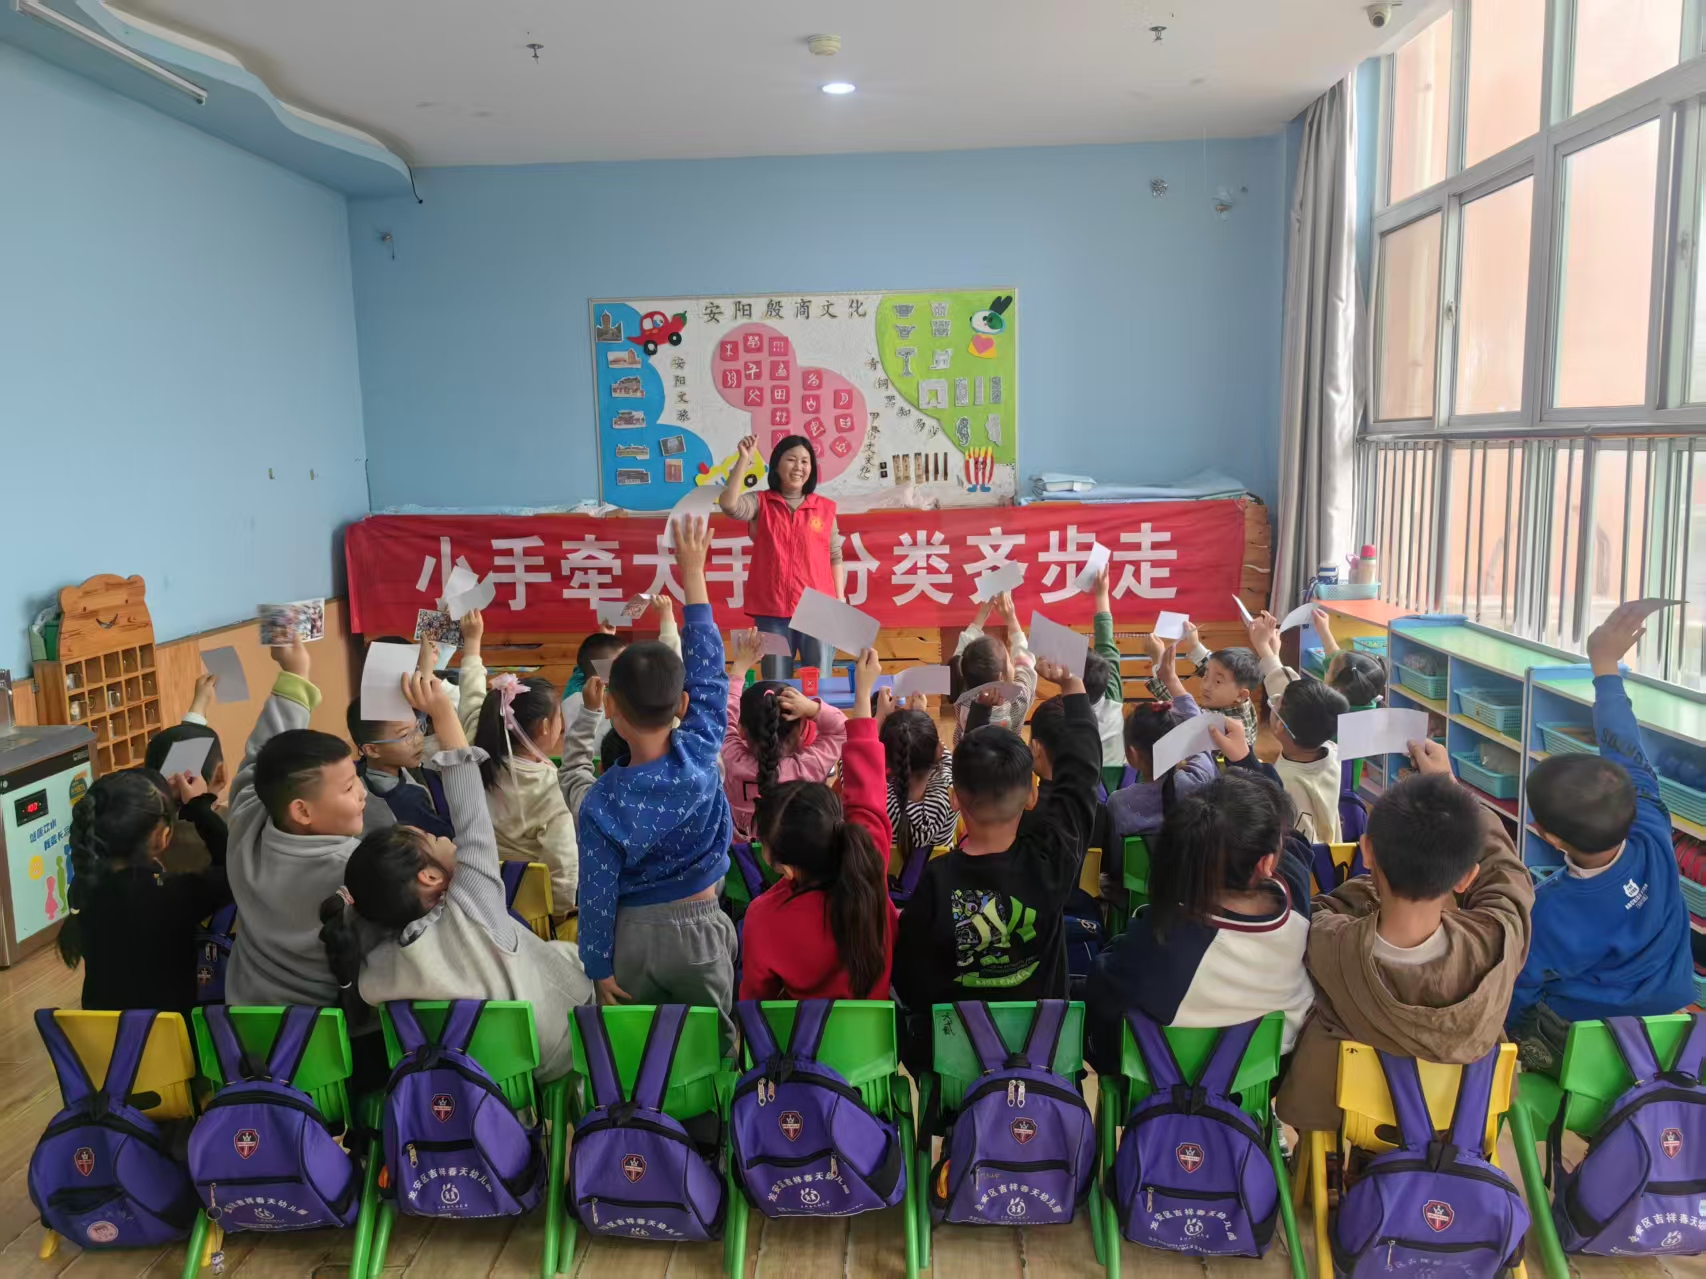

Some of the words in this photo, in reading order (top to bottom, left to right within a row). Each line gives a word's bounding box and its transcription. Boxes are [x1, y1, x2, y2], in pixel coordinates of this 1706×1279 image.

[704, 299, 867, 324] 安阳殷商文化
[672, 356, 691, 423] 安阳文旅
[866, 357, 940, 438] 青铜器知多少
